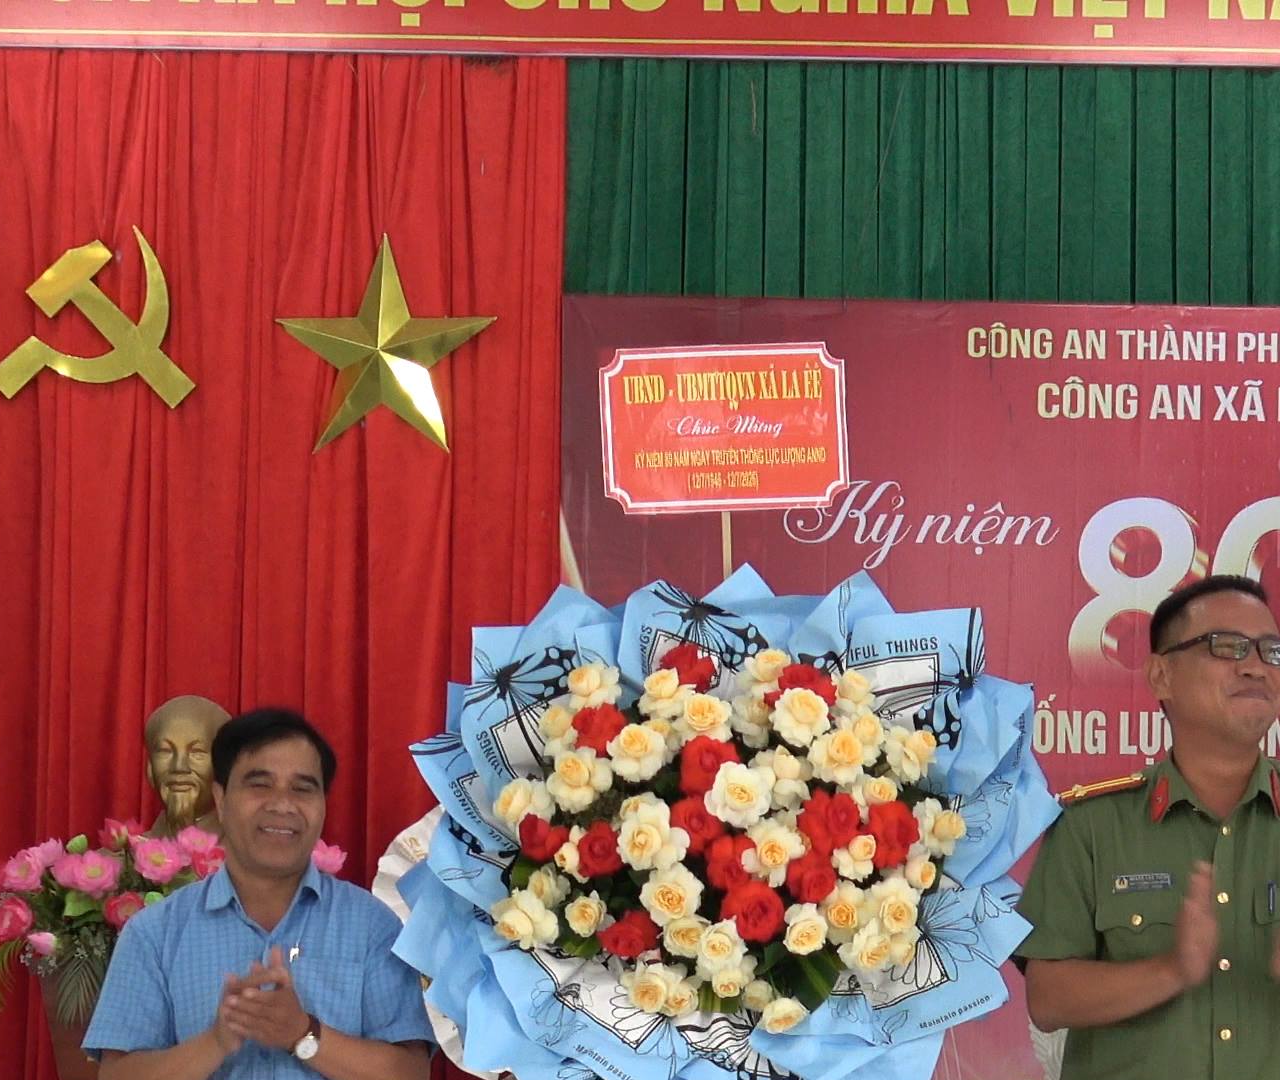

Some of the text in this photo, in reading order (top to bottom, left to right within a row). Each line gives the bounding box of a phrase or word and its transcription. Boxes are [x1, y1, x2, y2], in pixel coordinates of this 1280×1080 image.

[967, 322, 1053, 359] CÔNG
[1062, 329, 1106, 360] AN
[1116, 324, 1226, 362] THÀNH
[623, 375, 665, 405] UBND
[781, 370, 801, 399] LA
[1037, 376, 1139, 420] CÔNG
[1149, 384, 1201, 420] AN
[1213, 380, 1266, 422] XÃ
[783, 480, 1060, 569] Kỷ niệm
[885, 637, 938, 654] THINGS
[1033, 694, 1107, 755] ỐNG
[1119, 709, 1174, 765] LỰ
